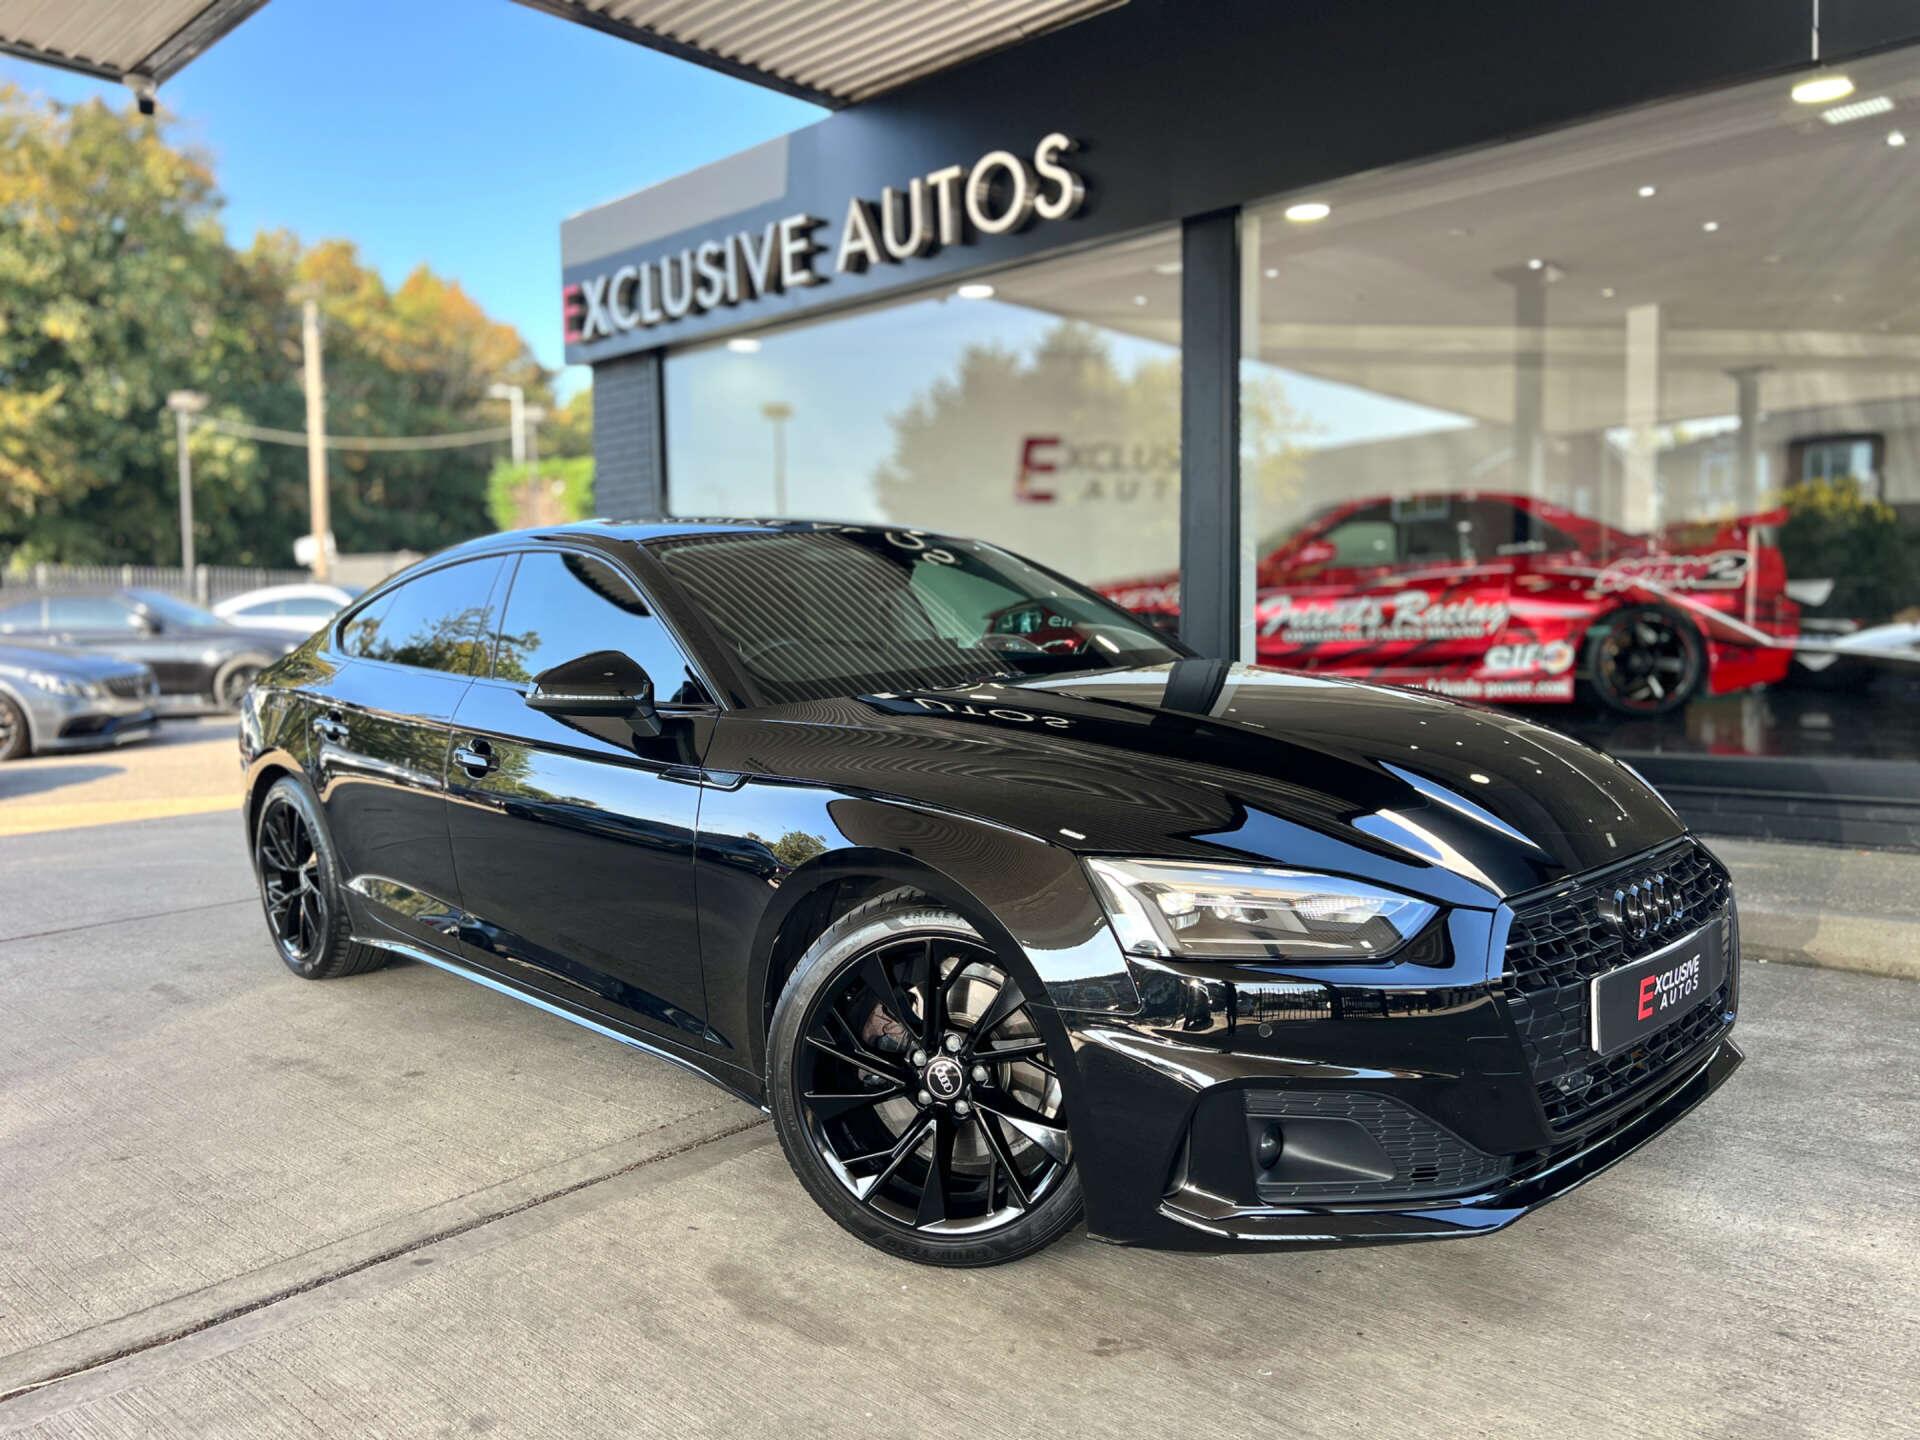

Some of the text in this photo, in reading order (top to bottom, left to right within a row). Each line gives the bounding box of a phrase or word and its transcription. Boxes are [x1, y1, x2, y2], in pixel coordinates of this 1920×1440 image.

[563, 133, 1084, 343] EXCLUSIVE AUTOS
[1080, 481, 1170, 503] AUT
[1391, 590, 1509, 633] Racing
[1638, 954, 1700, 1021] EXCLUSIVE
[1660, 974, 1699, 1010] AUTOS
